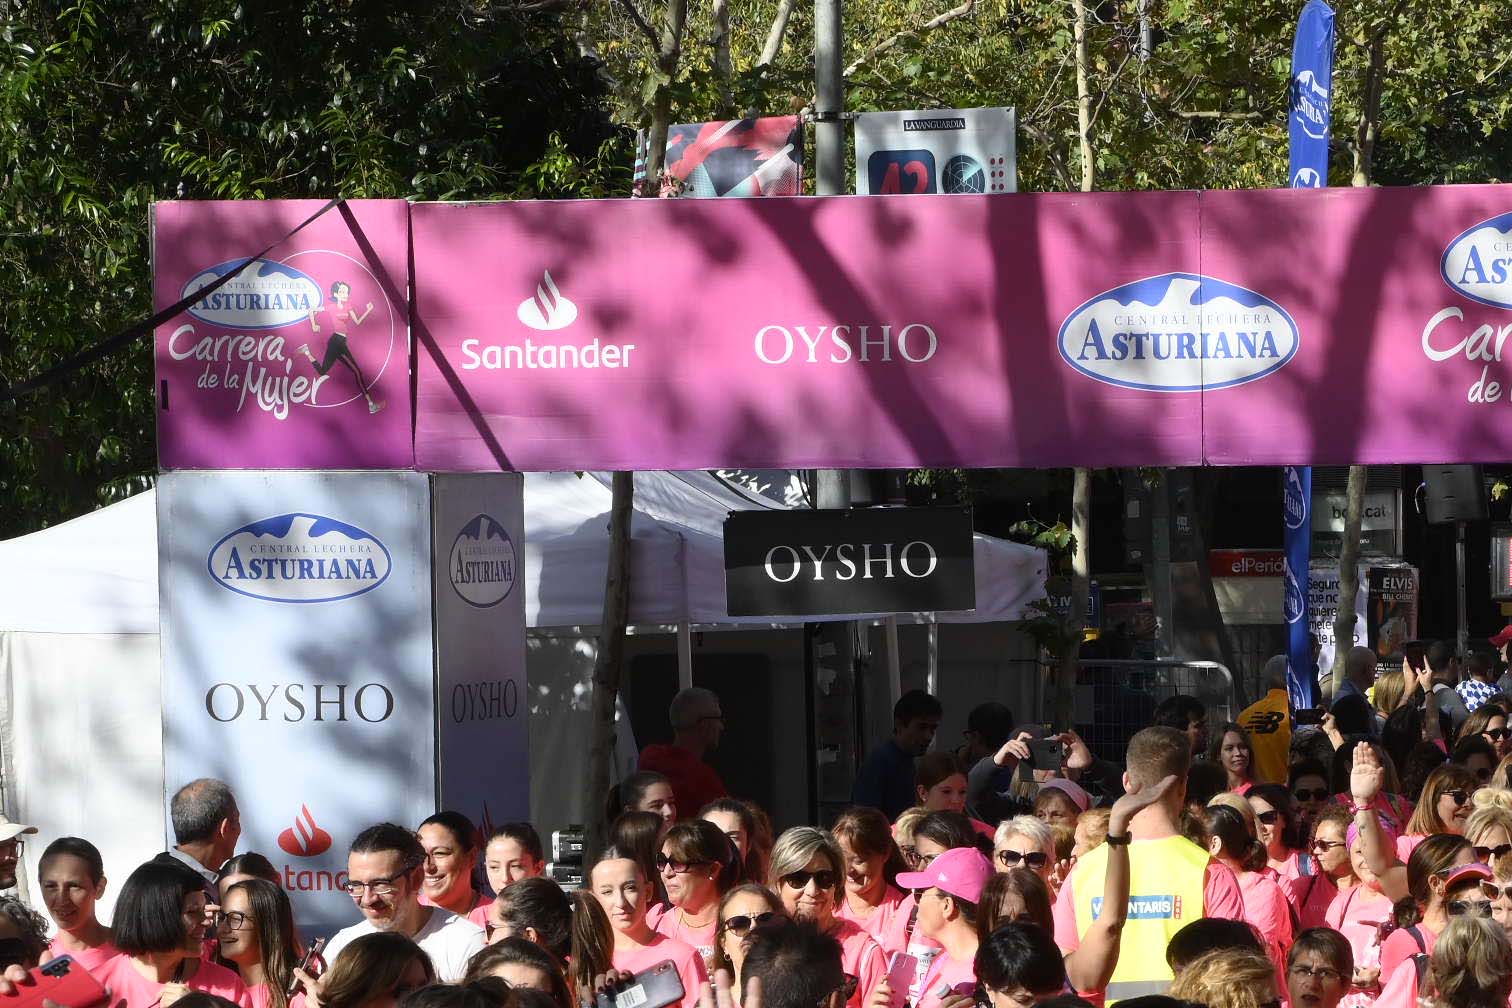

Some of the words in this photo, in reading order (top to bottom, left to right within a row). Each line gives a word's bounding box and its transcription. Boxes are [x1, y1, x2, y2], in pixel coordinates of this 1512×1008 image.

[191, 283, 312, 313] ASTURIANA
[1114, 313, 1189, 326] CENTRAL
[1197, 312, 1272, 325] LECHERA
[168, 324, 284, 362] Carrera
[461, 337, 635, 370] Santander
[754, 324, 938, 364] OYSHO
[1077, 317, 1280, 361] ASTURIANA
[197, 363, 223, 389] de
[223, 361, 240, 389] la
[236, 361, 330, 420] Mujer
[1467, 366, 1501, 405] de
[222, 546, 378, 581] ASTURIANA
[250, 544, 308, 554] CENTRAL
[314, 544, 373, 553] LECHERA
[764, 541, 938, 583] OYSHO
[1231, 556, 1287, 573] elPerió
[454, 553, 513, 585] ASTURIANA
[1382, 577, 1413, 590] ELVIS
[1308, 605, 1340, 617] quiere
[1309, 619, 1335, 630] mete
[206, 682, 395, 723] OYSHO
[451, 678, 519, 723] OYSHO
[1092, 900, 1171, 914] VNTARIS
